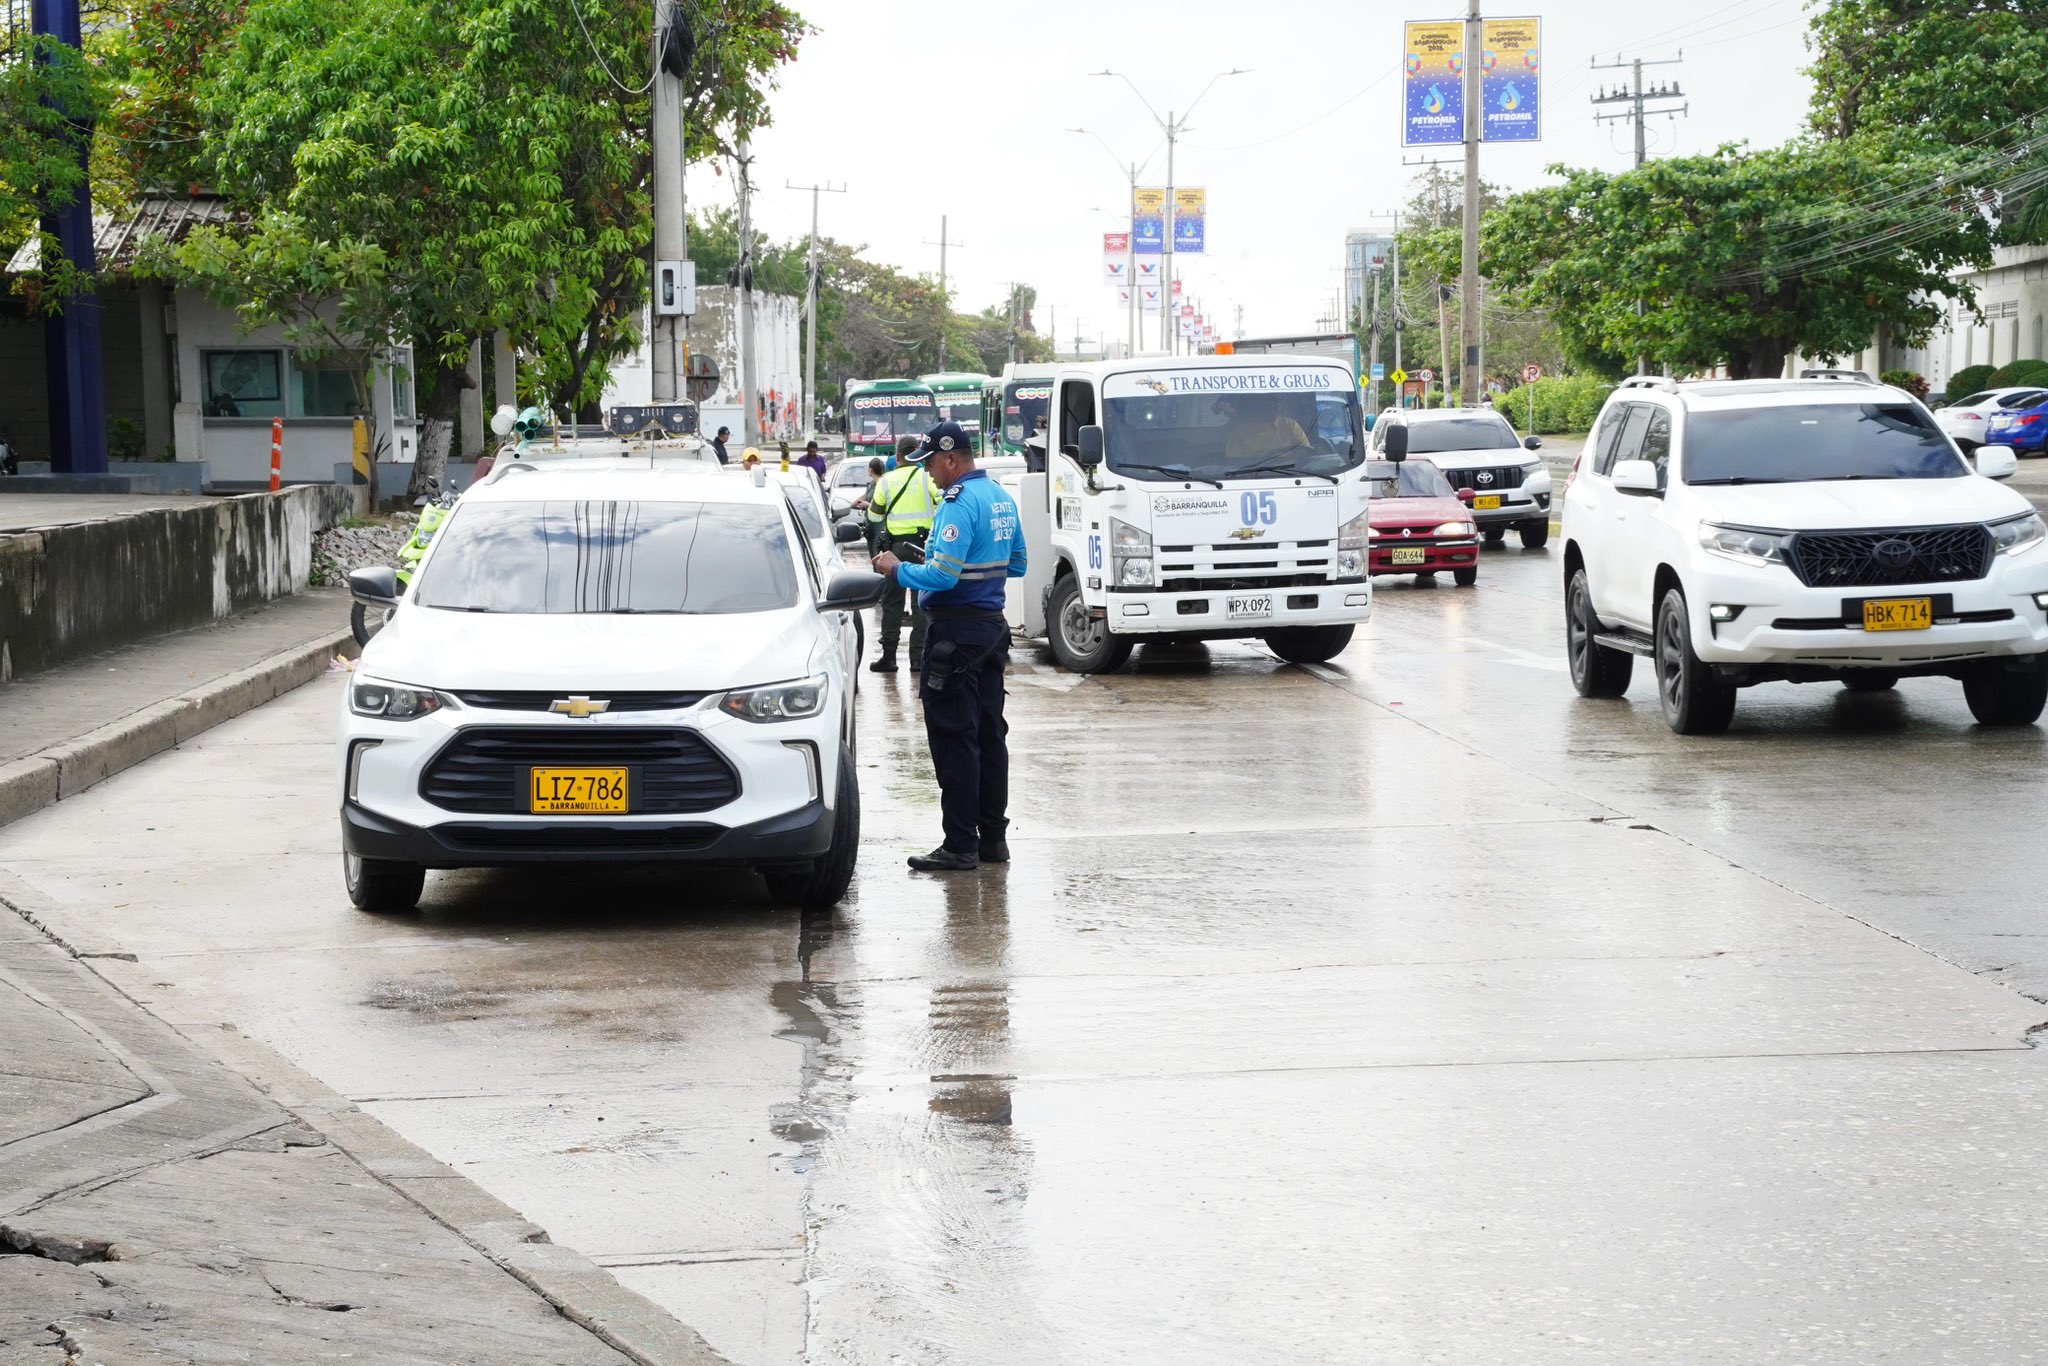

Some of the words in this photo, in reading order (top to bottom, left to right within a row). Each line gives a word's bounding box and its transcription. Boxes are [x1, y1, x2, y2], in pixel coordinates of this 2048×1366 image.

[1412, 116, 1456, 124] PETROMIL
[1488, 113, 1532, 121] PETROMIL
[1170, 375, 1266, 390] TRANSPORTE
[1269, 375, 1280, 388] &
[1284, 374, 1330, 388] GRUAS
[1171, 501, 1227, 510] BARRANQUILLA
[1241, 491, 1276, 526] 05
[1089, 535, 1102, 569] 05
